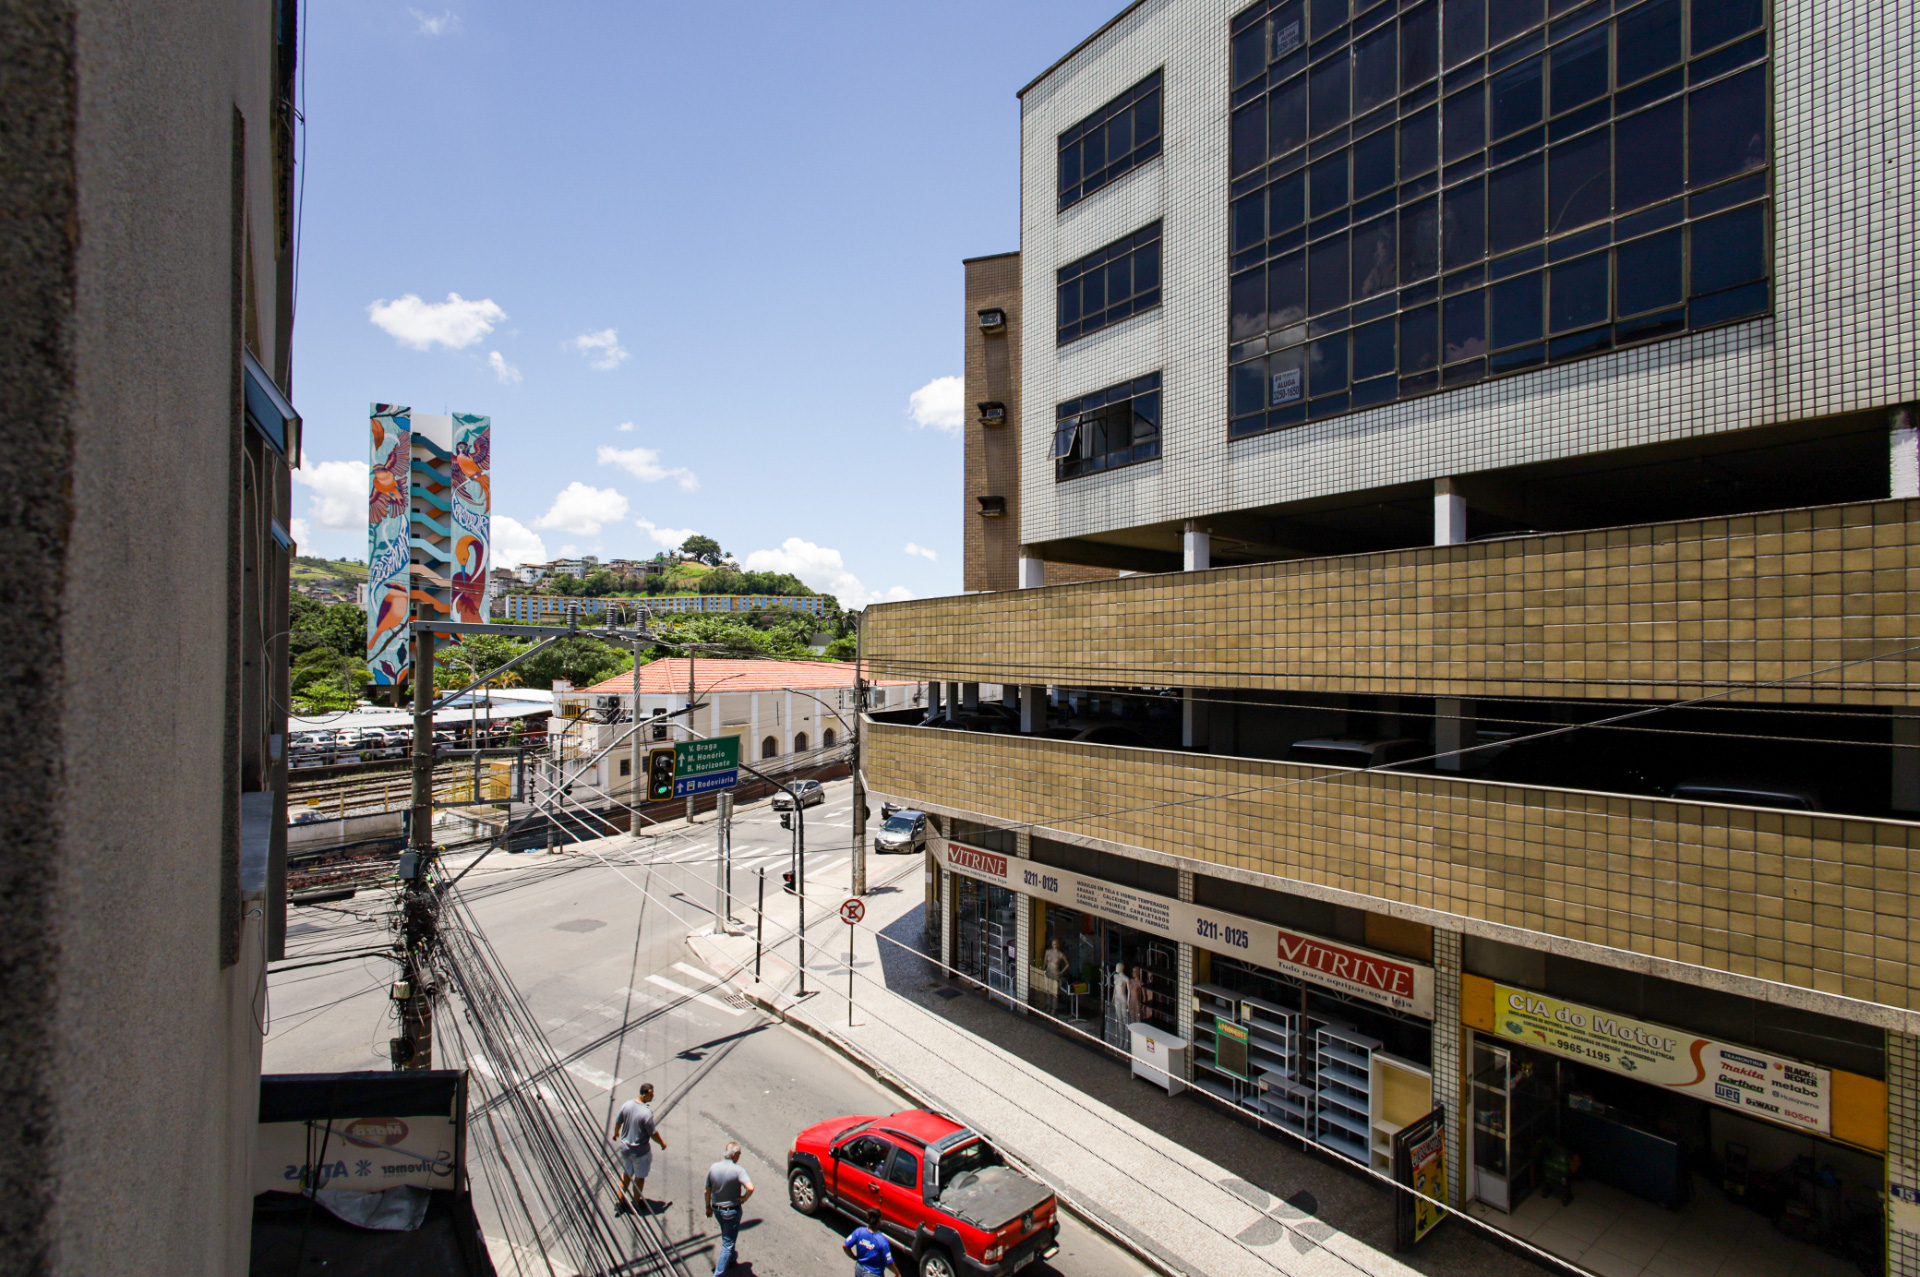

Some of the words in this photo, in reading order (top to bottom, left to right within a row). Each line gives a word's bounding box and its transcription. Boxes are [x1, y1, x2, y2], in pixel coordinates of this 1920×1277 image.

[1277, 379, 1295, 389] ALUGA
[696, 744, 717, 752] Braga
[697, 751, 725, 761] Honório
[696, 760, 730, 771] Horizonte
[697, 776, 734, 788] Rodoviária
[949, 846, 1005, 876] VITRINE
[1076, 893, 1097, 902] CABIDES
[1106, 900, 1126, 911] PAINÉIS
[1130, 908, 1169, 924] CANALETADOS
[1077, 887, 1094, 896] ARARAS
[1103, 894, 1129, 905] CALCEIROS
[1138, 904, 1169, 917] MANEQUINS
[1138, 897, 1169, 910] TEMPERADOS
[1100, 905, 1138, 921] SUPERMERCADOS
[1280, 937, 1409, 996] VITRINE
[1277, 960, 1300, 973] Tudo
[1302, 970, 1324, 981] para
[1391, 995, 1412, 1008] loja
[1508, 993, 1550, 1018] CIA
[1555, 1007, 1586, 1028] do
[1593, 1015, 1677, 1052] Motor
[1557, 1039, 1610, 1063] 9965-1195
[1619, 1040, 1649, 1053] FERRAMENTAS
[1723, 1051, 1764, 1068] TRAMONTINA
[1718, 1073, 1764, 1092] Garthen
[1784, 1072, 1818, 1087] DECKER
[1771, 1080, 1819, 1098] metabo
[1780, 1094, 1820, 1109] Husqvarna
[1784, 1109, 1818, 1125] BOSCH
